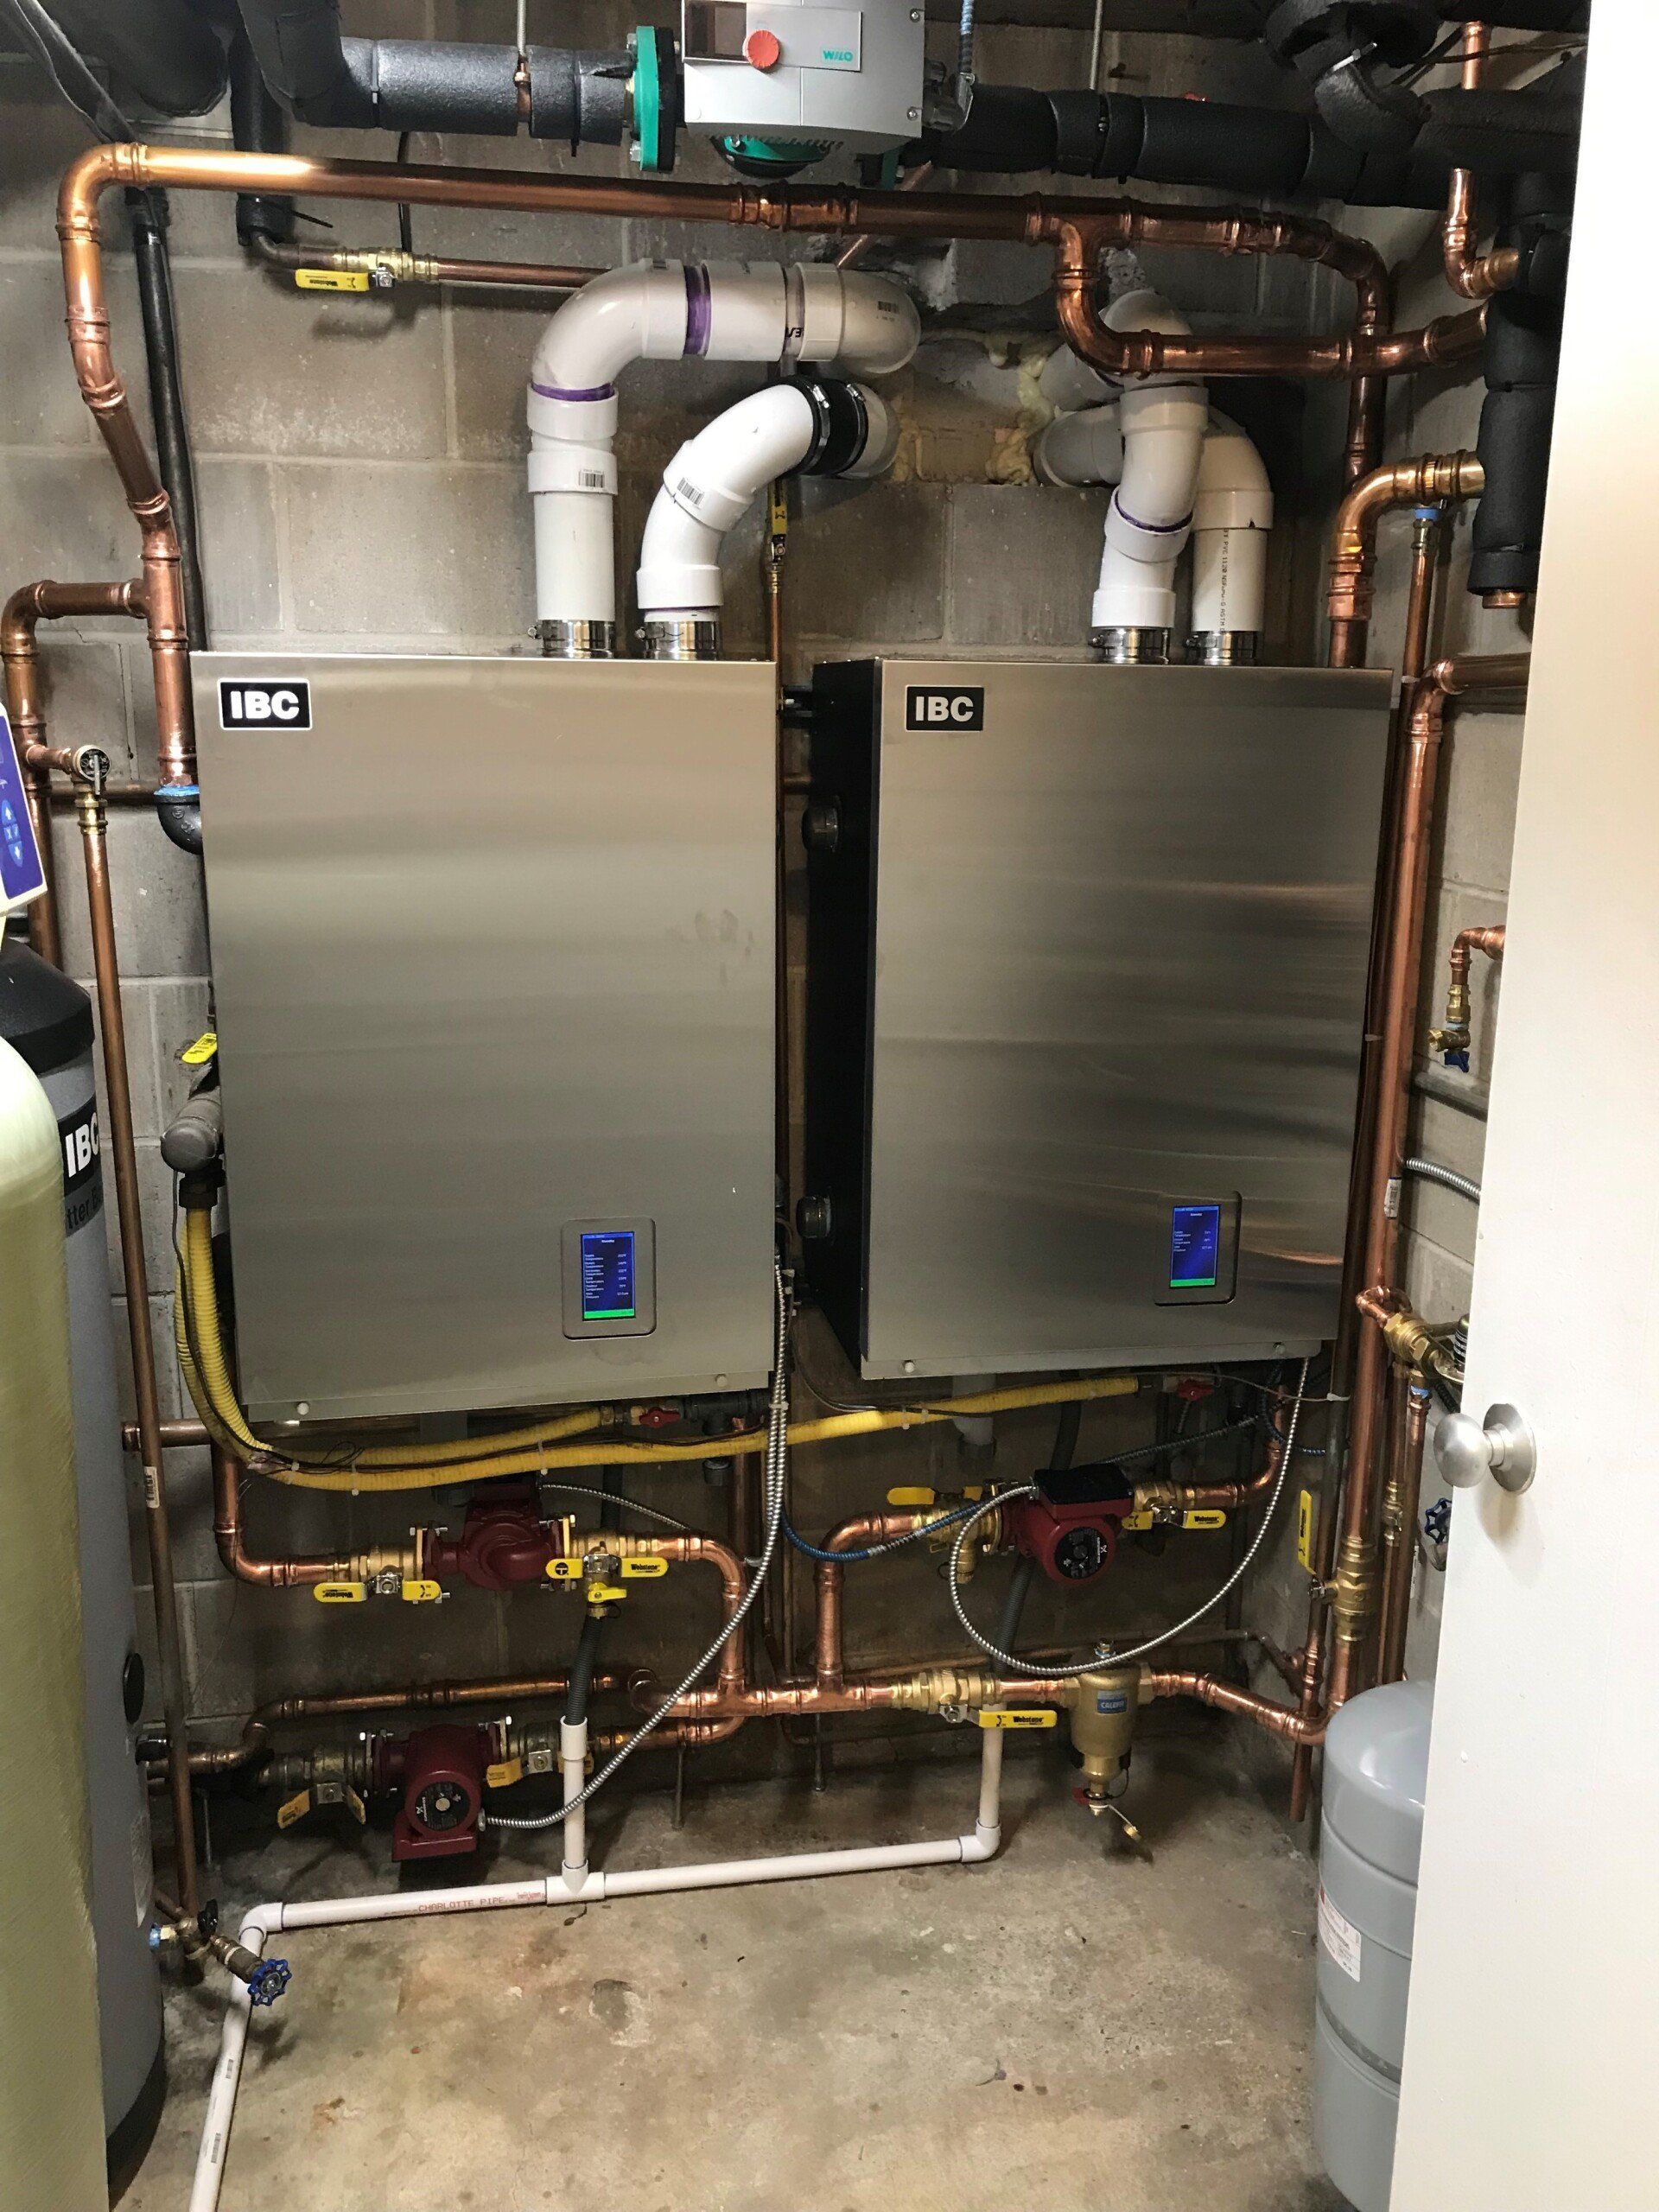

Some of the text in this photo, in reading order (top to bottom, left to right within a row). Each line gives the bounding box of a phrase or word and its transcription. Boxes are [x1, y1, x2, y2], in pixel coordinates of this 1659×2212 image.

[823, 50, 854, 61] WILO
[230, 690, 300, 720] IBC
[915, 696, 974, 722] IBC
[65, 1112, 99, 1178] IBC
[418, 1899, 474, 1912] CHARLOTTE
